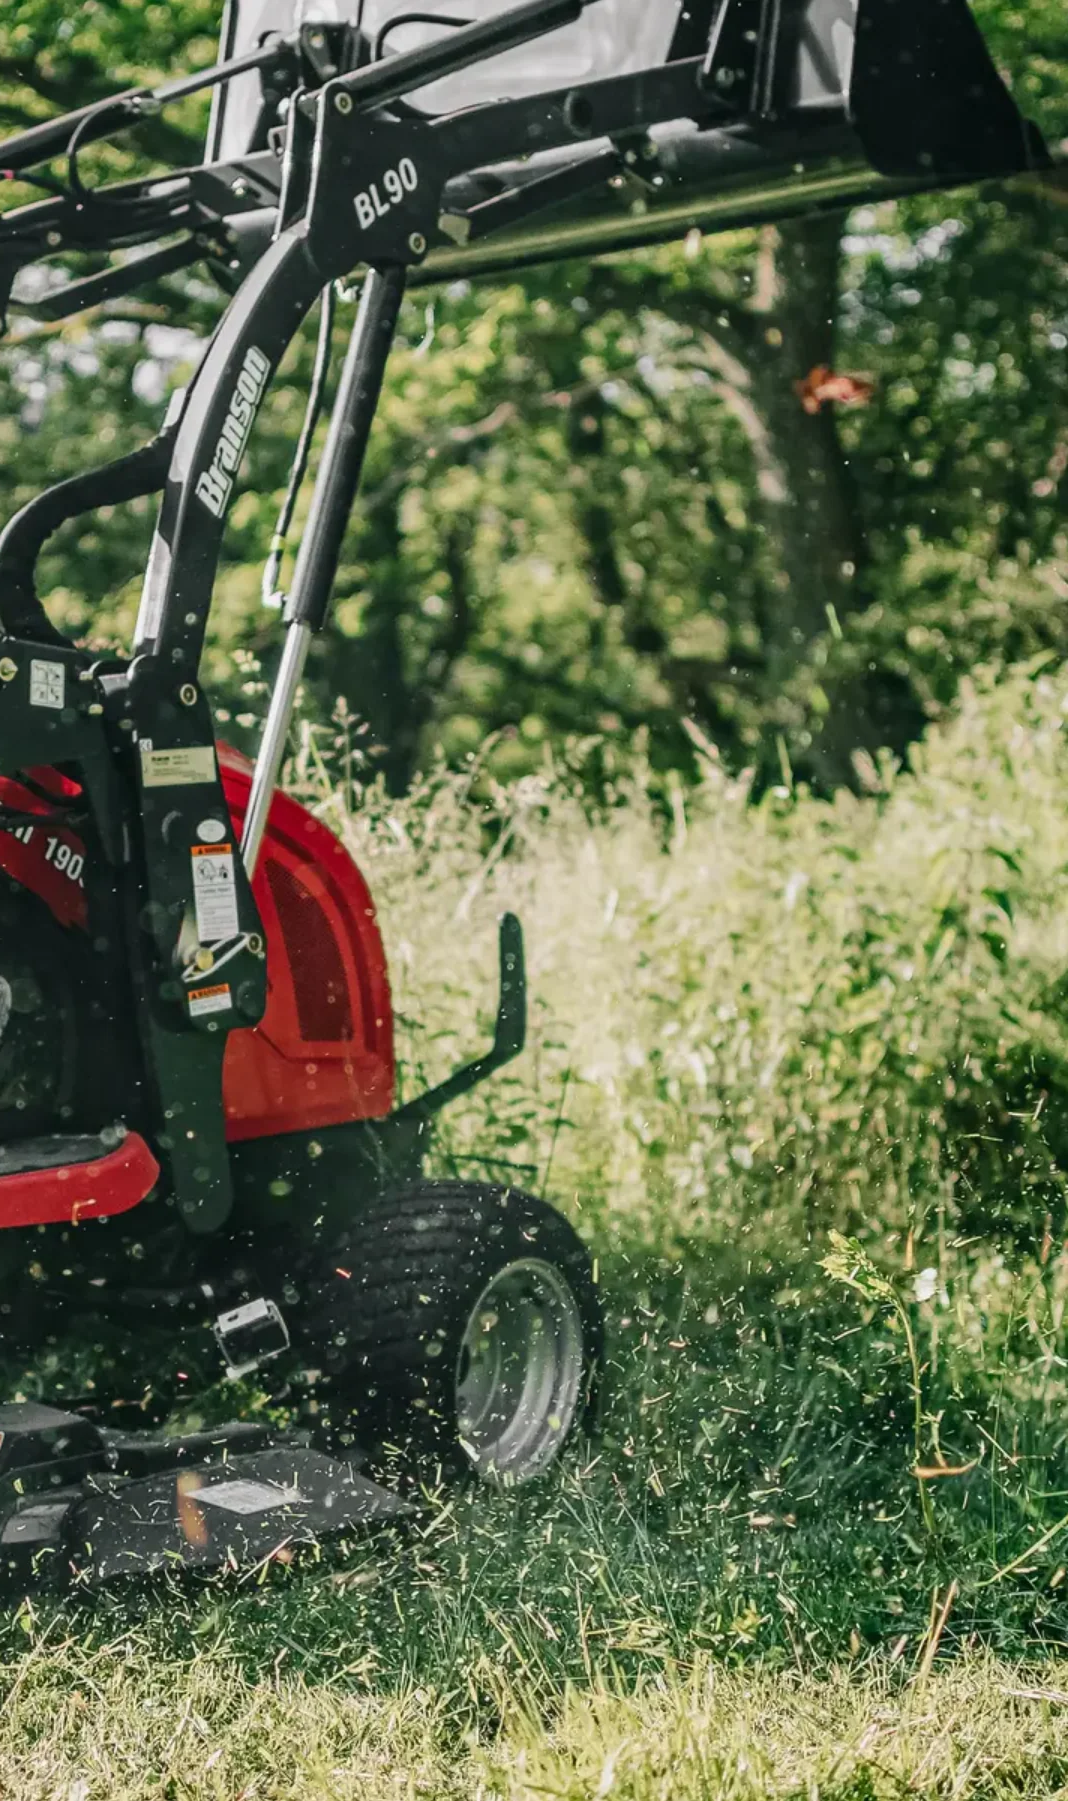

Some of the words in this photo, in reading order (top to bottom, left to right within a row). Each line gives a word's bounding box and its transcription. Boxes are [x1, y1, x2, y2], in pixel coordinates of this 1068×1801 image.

[353, 157, 419, 230] BL90
[194, 345, 271, 519] Branson
[44, 836, 84, 888] 190
